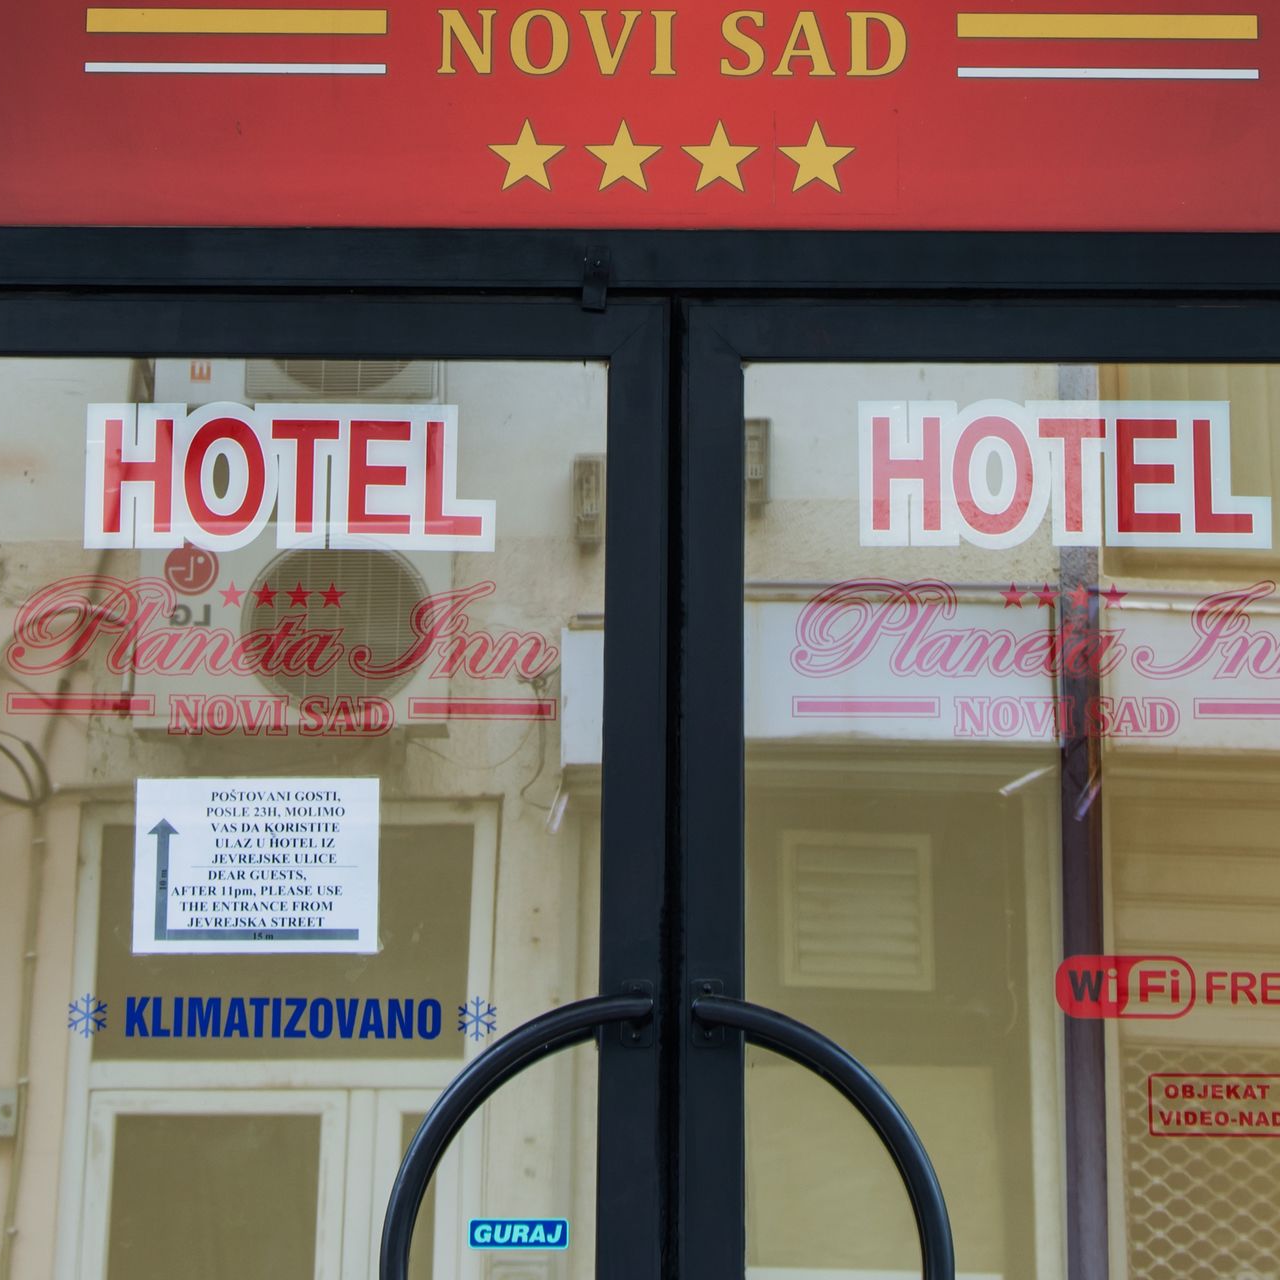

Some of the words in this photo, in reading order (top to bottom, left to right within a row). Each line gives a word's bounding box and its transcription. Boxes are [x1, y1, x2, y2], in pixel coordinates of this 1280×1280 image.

[436, 7, 677, 78] NOVI
[719, 9, 909, 80] SAD
[102, 418, 483, 537] HOTEL
[872, 416, 1255, 535] HOTEL
[7, 575, 345, 678] Planeta
[348, 581, 559, 680] Inn
[789, 577, 1127, 680] Planeta
[168, 694, 289, 736] NOVI
[298, 696, 395, 737] SAD
[954, 696, 1075, 737] NOVI
[1082, 696, 1180, 738] SAD
[211, 789, 291, 802] POŠTOVANI
[294, 791, 341, 803] GOSTI,
[206, 806, 250, 817] POSLE
[254, 807, 281, 818] 23H,
[285, 807, 345, 817] MOLIMO
[211, 823, 237, 833] VAS
[241, 823, 259, 833] DA
[264, 822, 340, 833] KORISTITE
[215, 838, 252, 849] ULAZ
[256, 838, 266, 849] U
[269, 838, 317, 849] HOTEL
[321, 838, 335, 849] IZ
[211, 854, 291, 864] JEVREJSKE
[294, 854, 337, 864] ULICE
[207, 870, 246, 880] DEAR
[249, 870, 307, 882] GUESTS,
[171, 886, 216, 896] AFTER
[222, 886, 257, 899] 11pm,
[260, 886, 312, 896] PLEASE
[317, 886, 343, 896] USE
[179, 901, 208, 912] THE
[212, 901, 288, 912] ENTRANCE
[292, 901, 333, 912] FROM
[187, 917, 267, 928] JEVREJSKA
[270, 917, 325, 928] STREET
[125, 996, 442, 1040] KLIMATIZOVANO
[1164, 1084, 1270, 1100] OBJEKAT
[473, 1223, 564, 1244] GURAJ
